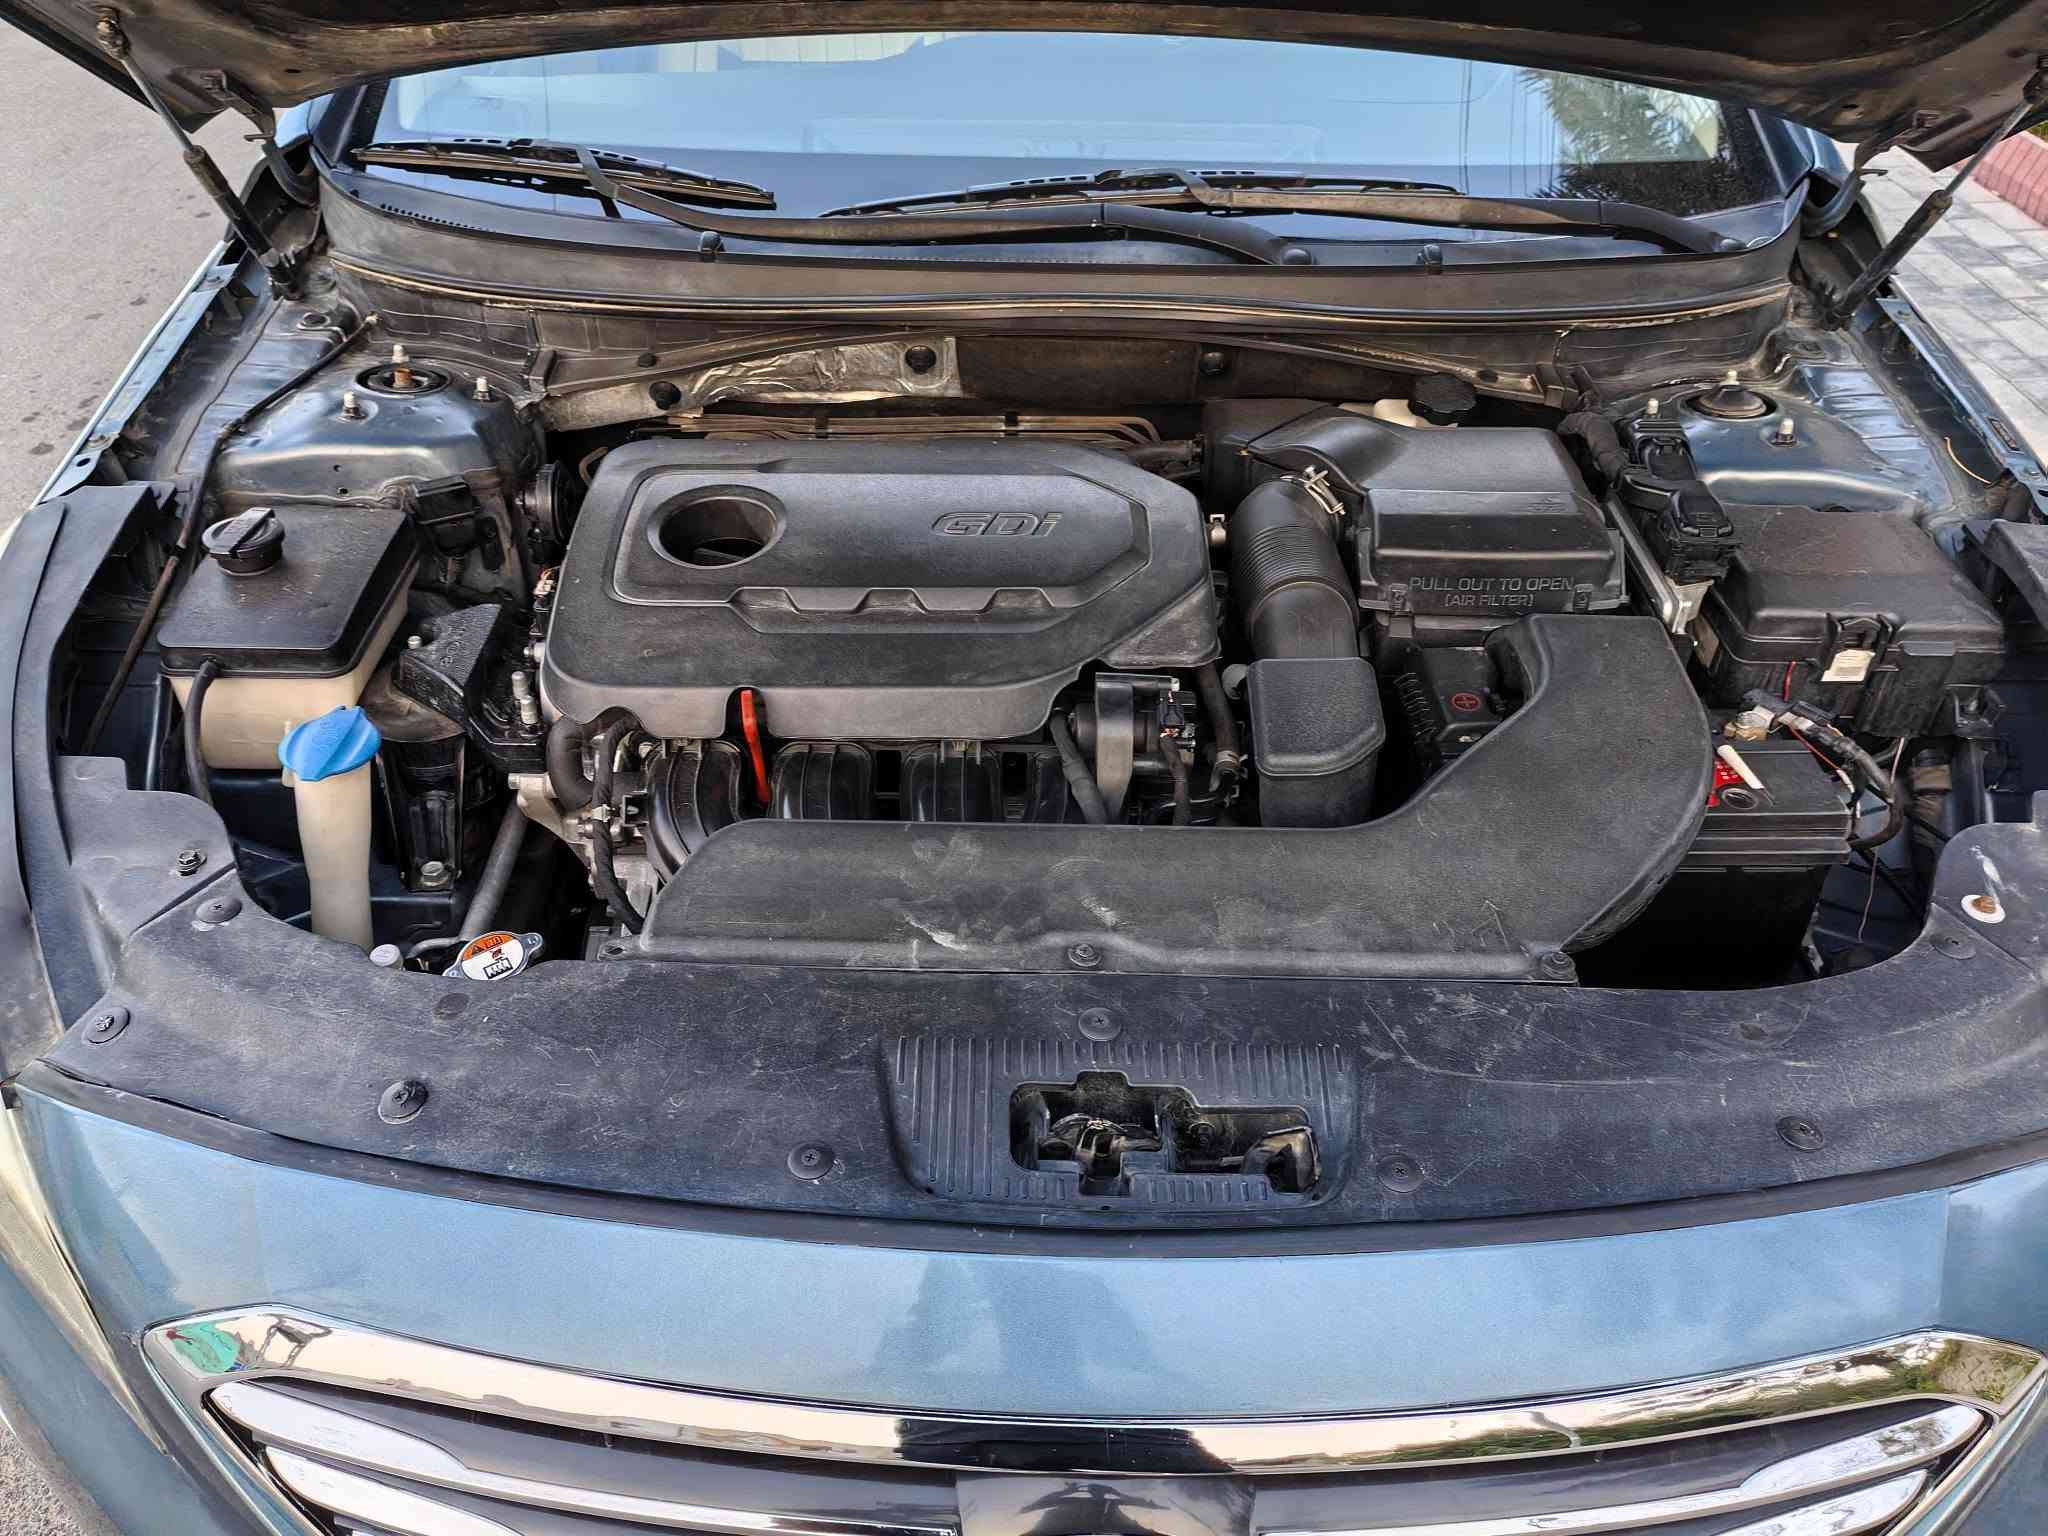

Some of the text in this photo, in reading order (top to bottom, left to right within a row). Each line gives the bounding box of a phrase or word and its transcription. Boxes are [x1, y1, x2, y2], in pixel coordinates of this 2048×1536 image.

[931, 511, 1062, 536] GDi
[1408, 576, 1574, 591] PULL OUT TO OPEN
